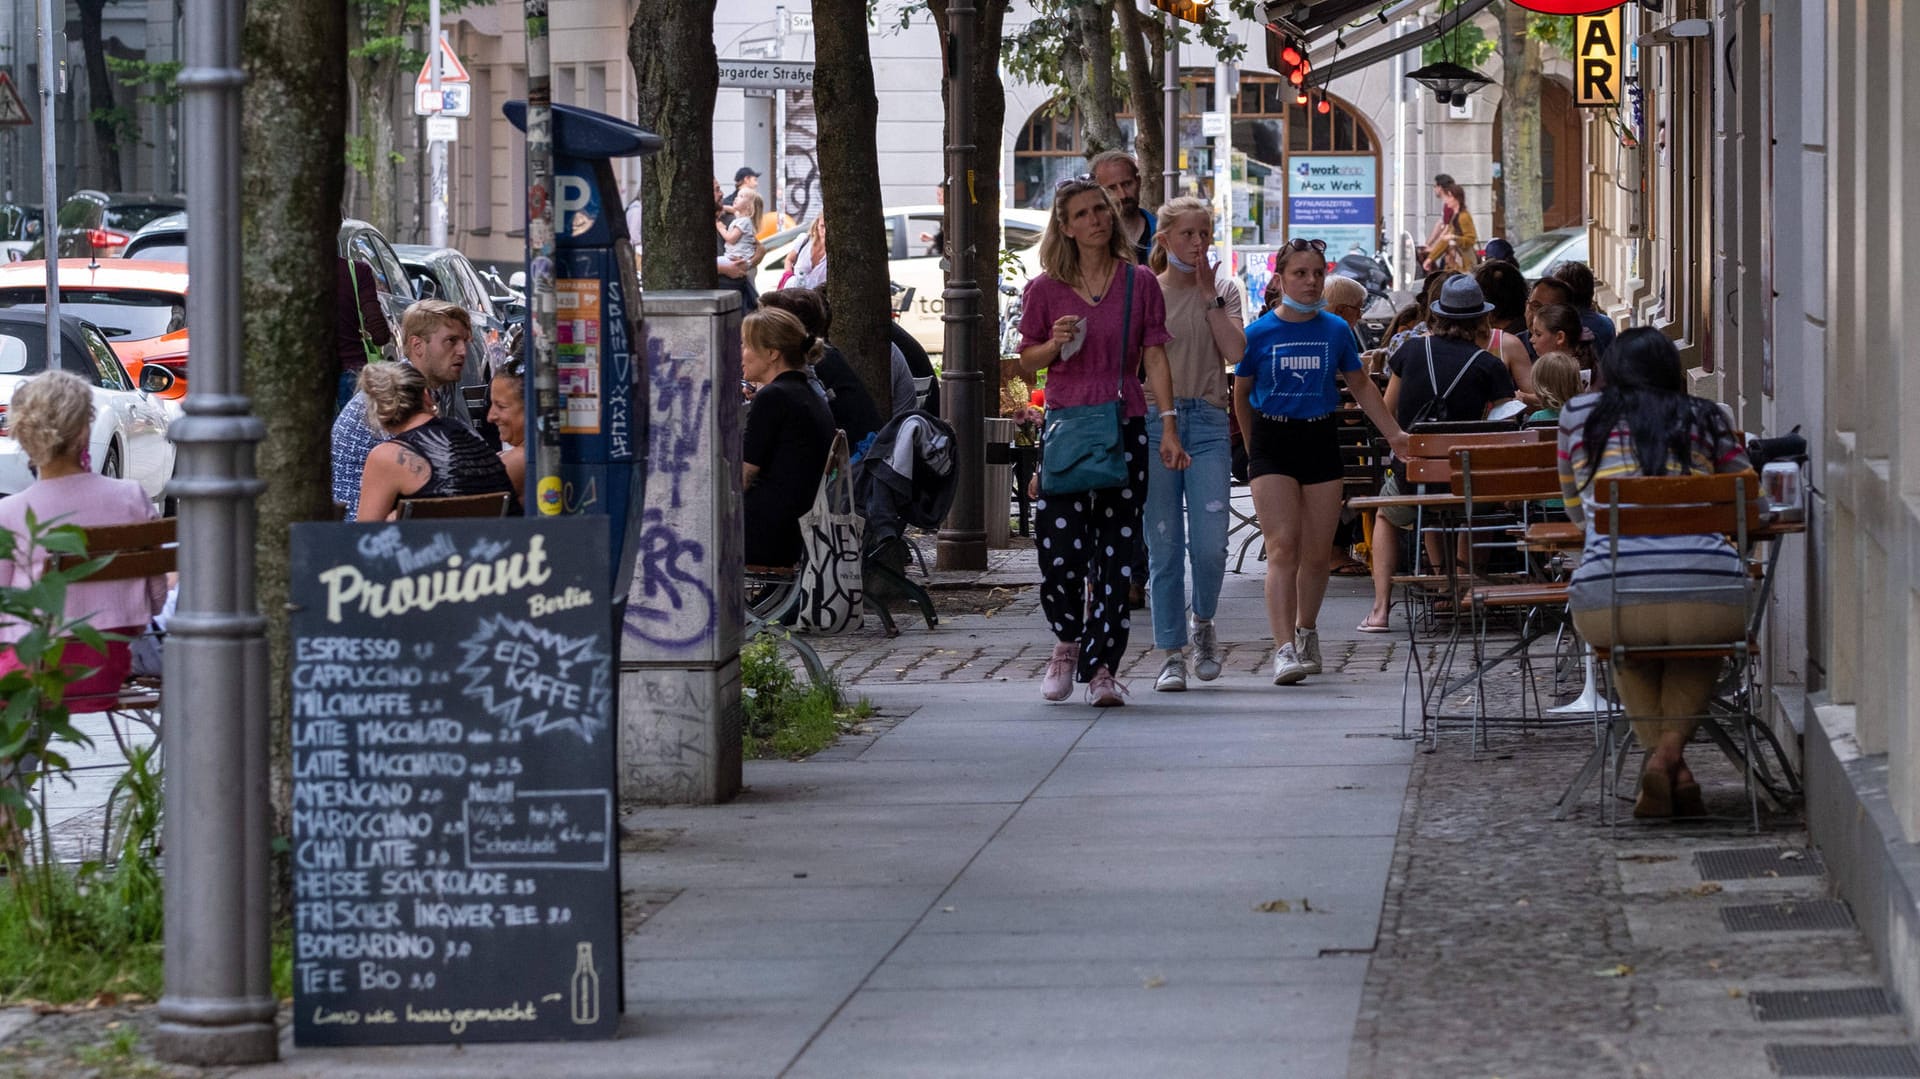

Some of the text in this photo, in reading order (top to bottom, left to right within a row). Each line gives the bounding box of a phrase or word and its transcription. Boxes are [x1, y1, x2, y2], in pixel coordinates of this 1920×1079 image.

[1581, 9, 1616, 99] AR
[718, 67, 813, 83] argarder Straße
[1301, 181, 1361, 191] Max Werk
[1280, 356, 1320, 370] PUMA
[319, 534, 551, 624] Proviant
[528, 587, 593, 618] Berlin
[296, 637, 401, 662] ESPRESSO
[494, 641, 540, 668] EIS
[292, 663, 423, 689] CAPPUCCINO
[292, 720, 348, 747] LATTE
[356, 718, 463, 747] MACCHIATO
[292, 750, 349, 779] LATTE
[356, 751, 467, 778] MACCHIATO
[292, 779, 413, 808] AMERICANO
[292, 809, 433, 839] MAROCCHINO
[297, 838, 347, 869] CHAI
[356, 839, 418, 868] LATTE
[296, 871, 371, 898] HEISSE
[380, 869, 508, 897] SCHOKOLADE
[295, 899, 402, 931] FRISCHER
[297, 931, 435, 960] BOMBARDINO
[405, 1002, 537, 1035] hausgemacht
